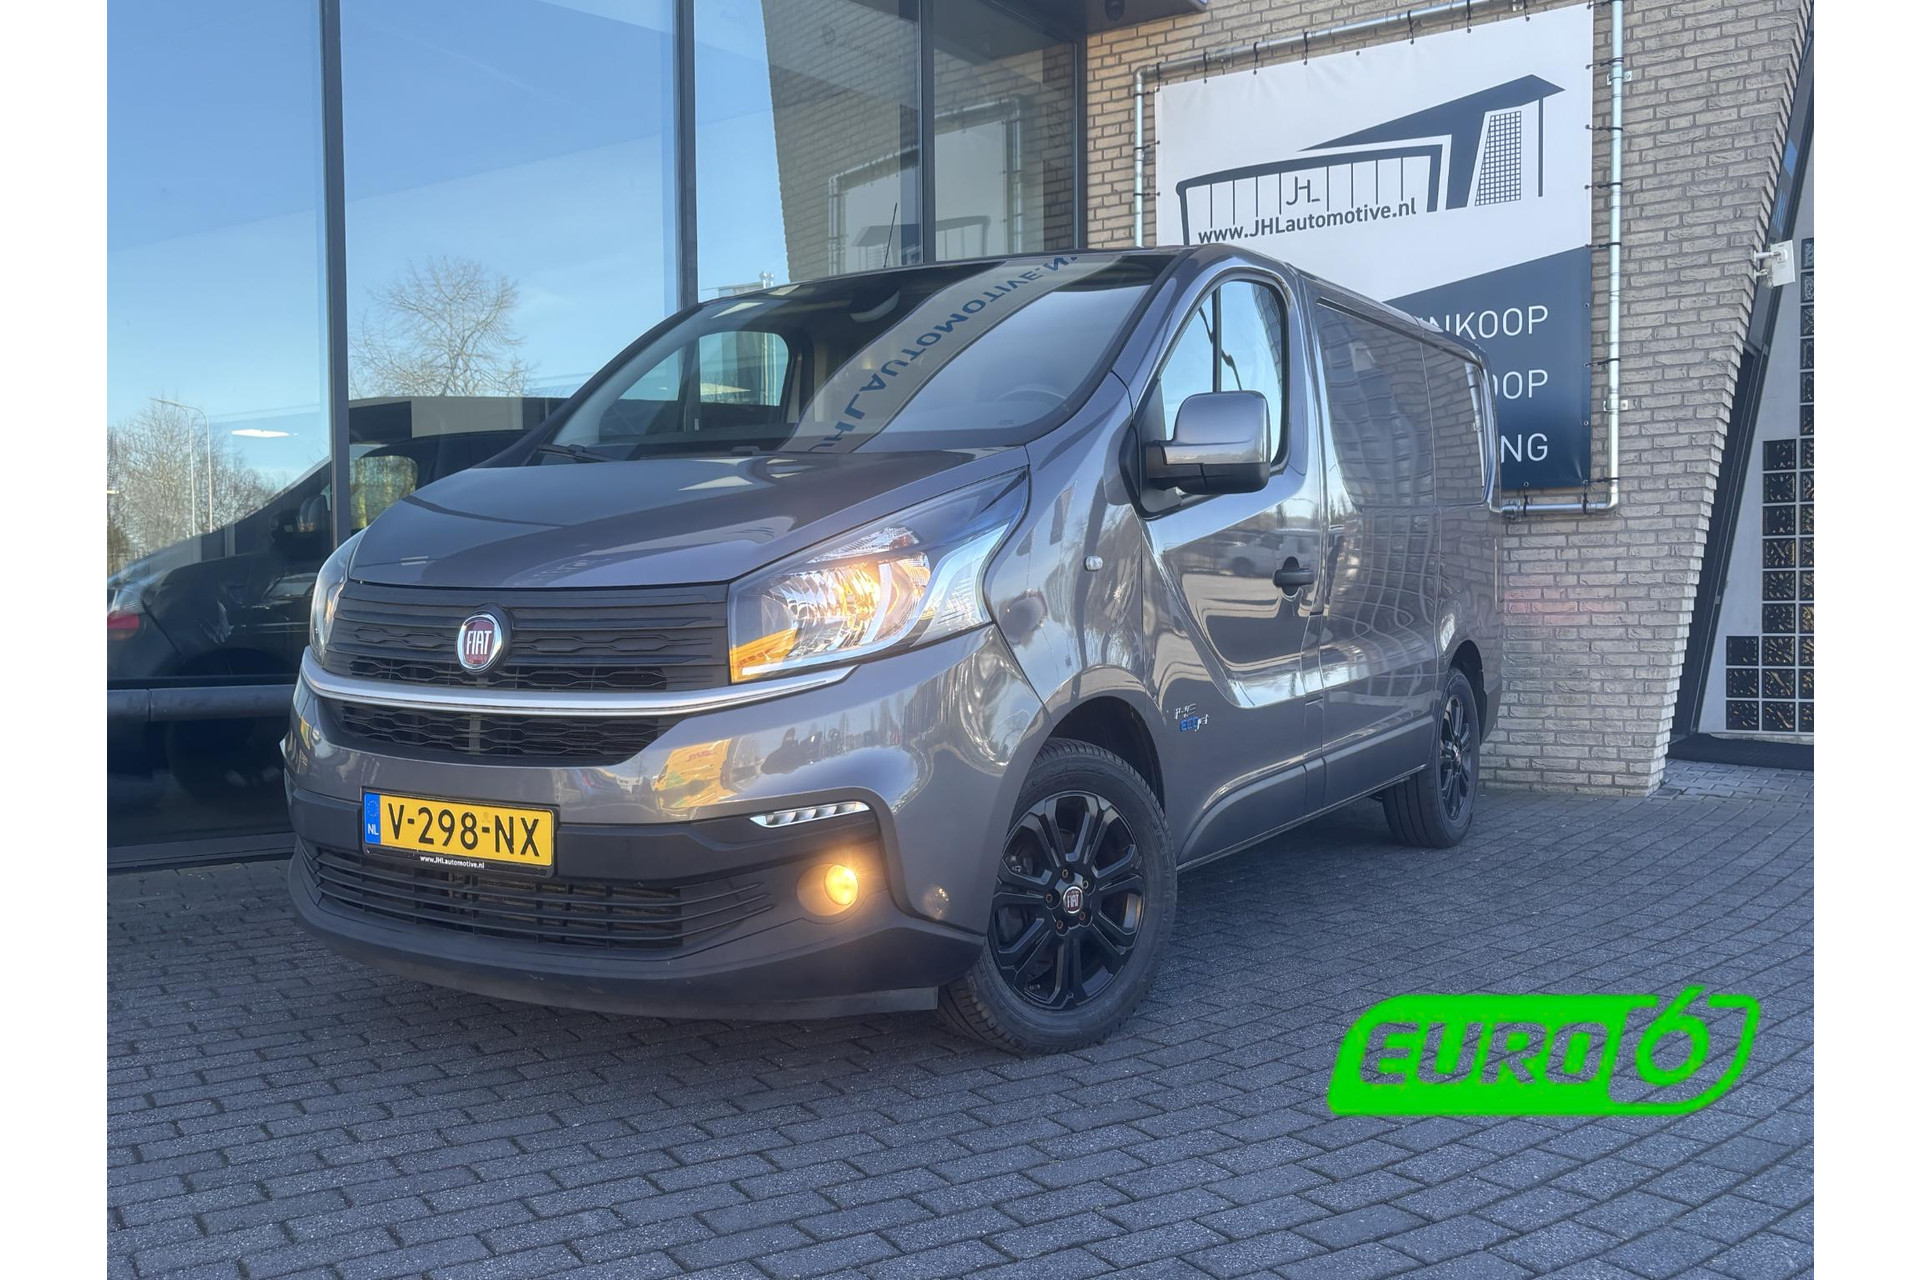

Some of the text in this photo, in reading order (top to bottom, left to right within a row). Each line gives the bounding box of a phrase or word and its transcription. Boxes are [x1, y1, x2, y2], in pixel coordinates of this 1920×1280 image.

[1198, 197, 1417, 244] www.JHLautomotive.nl
[466, 630, 493, 655] FIAT
[367, 823, 380, 836] NL
[387, 803, 541, 857] V-298-NX
[419, 855, 485, 869] www.JHLautomotive.nl
